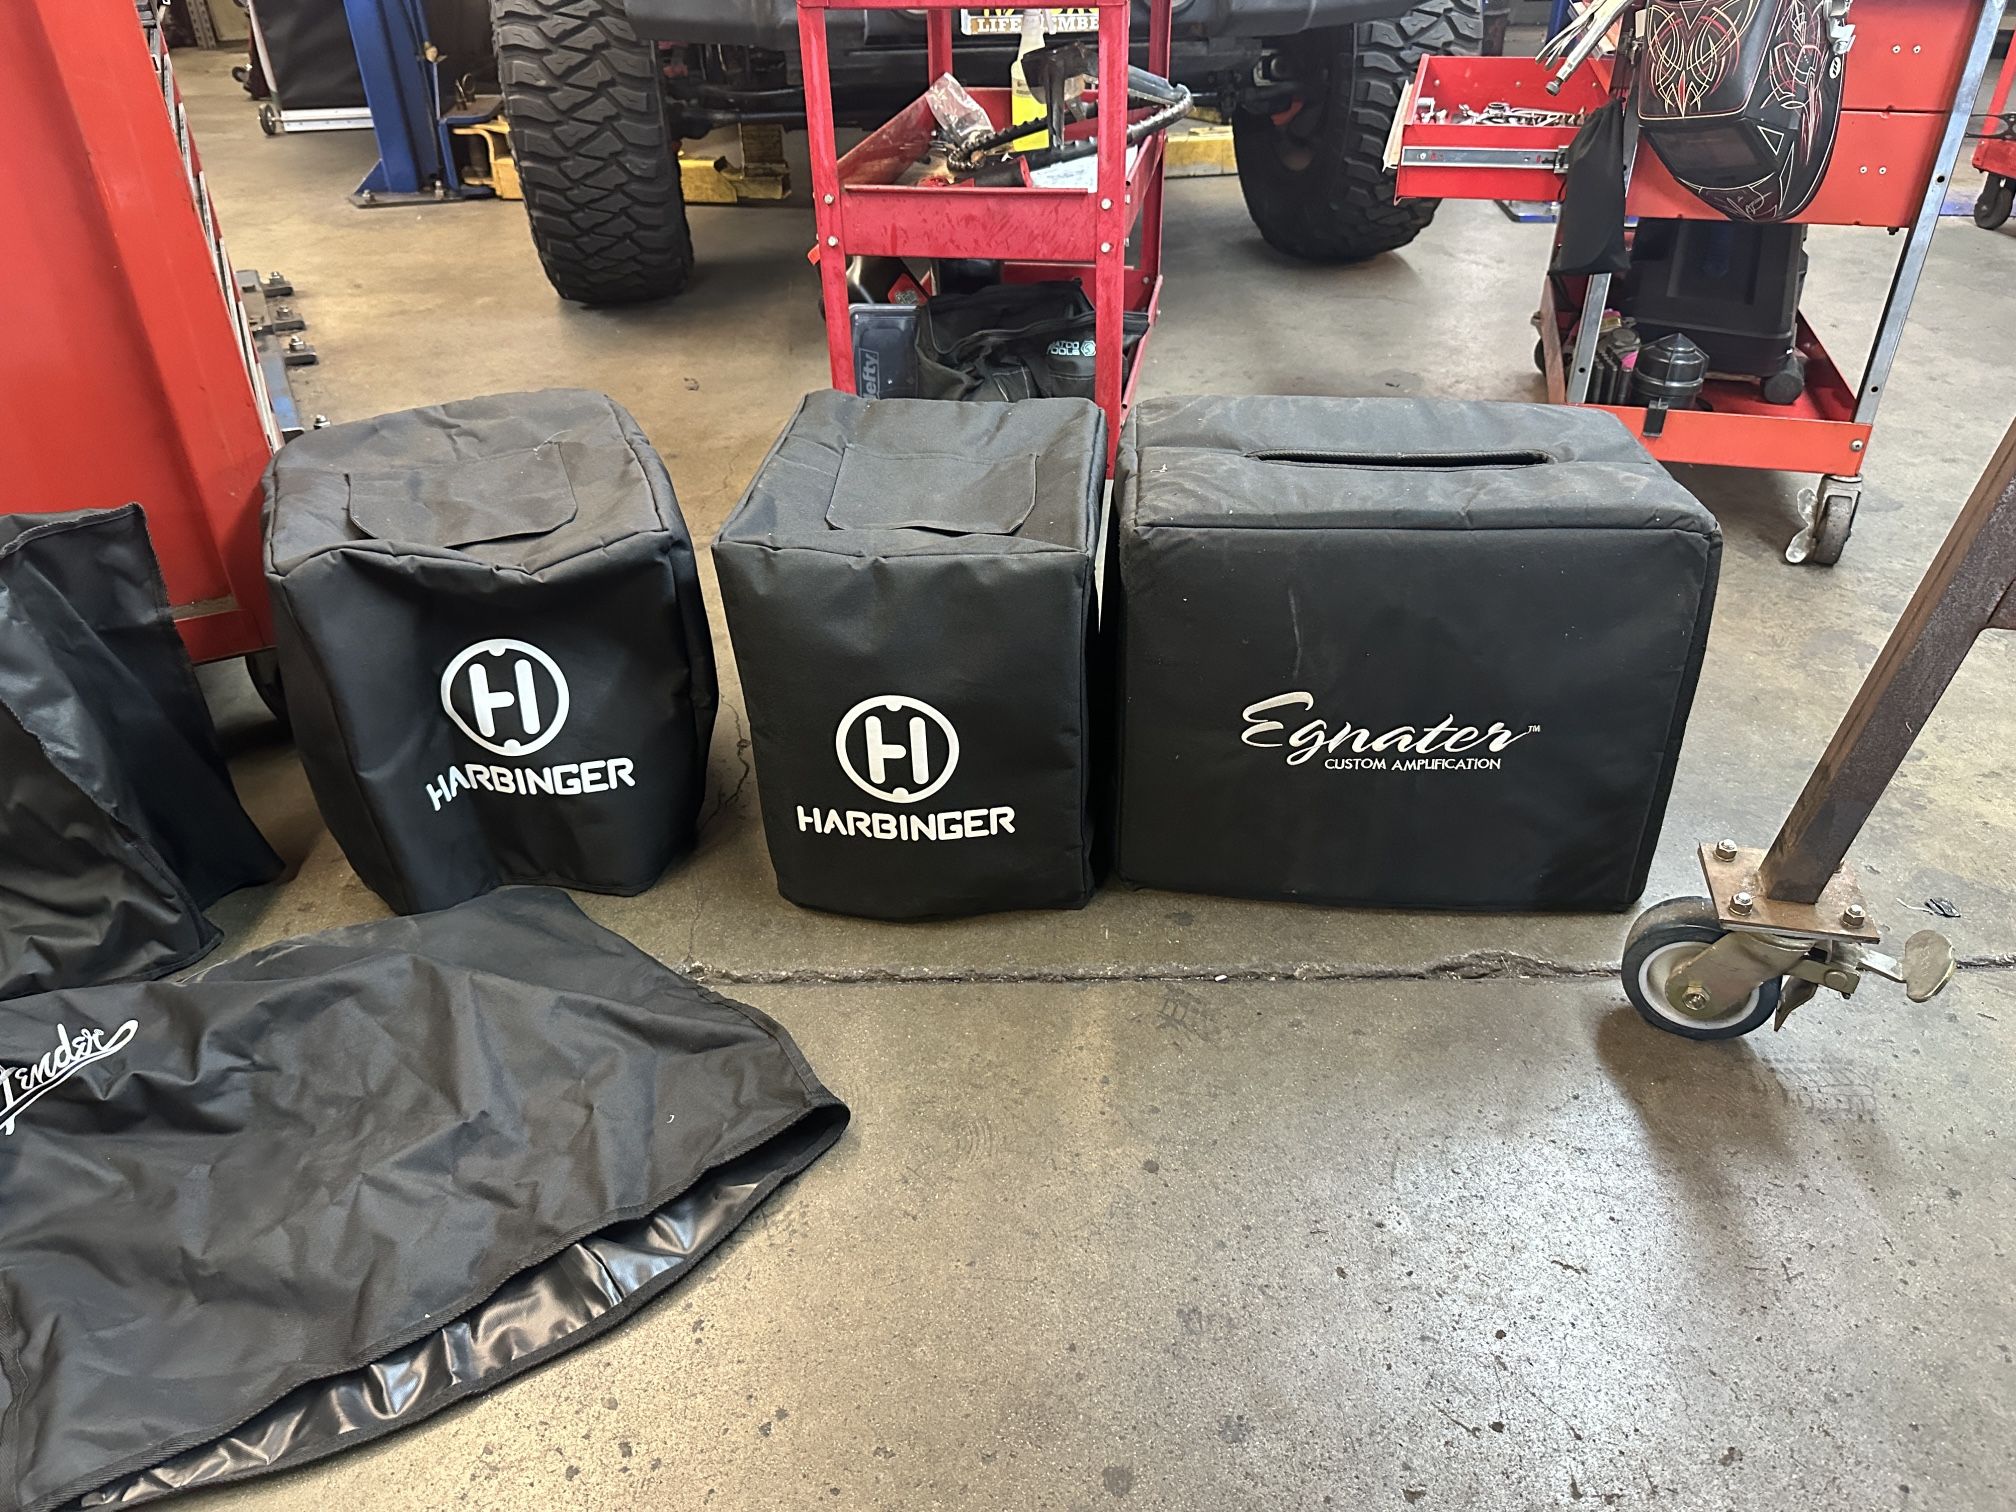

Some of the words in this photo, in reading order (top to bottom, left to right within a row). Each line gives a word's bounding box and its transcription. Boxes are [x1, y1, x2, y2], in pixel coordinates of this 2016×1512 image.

[978, 18, 1021, 33] LIFE
[1241, 691, 1530, 766] Egnater
[1324, 758, 1387, 771] CUSTOM
[1390, 757, 1501, 771] AMPLIFICATION
[425, 757, 636, 812] HARBINGER
[796, 805, 1016, 842] HARBINGER
